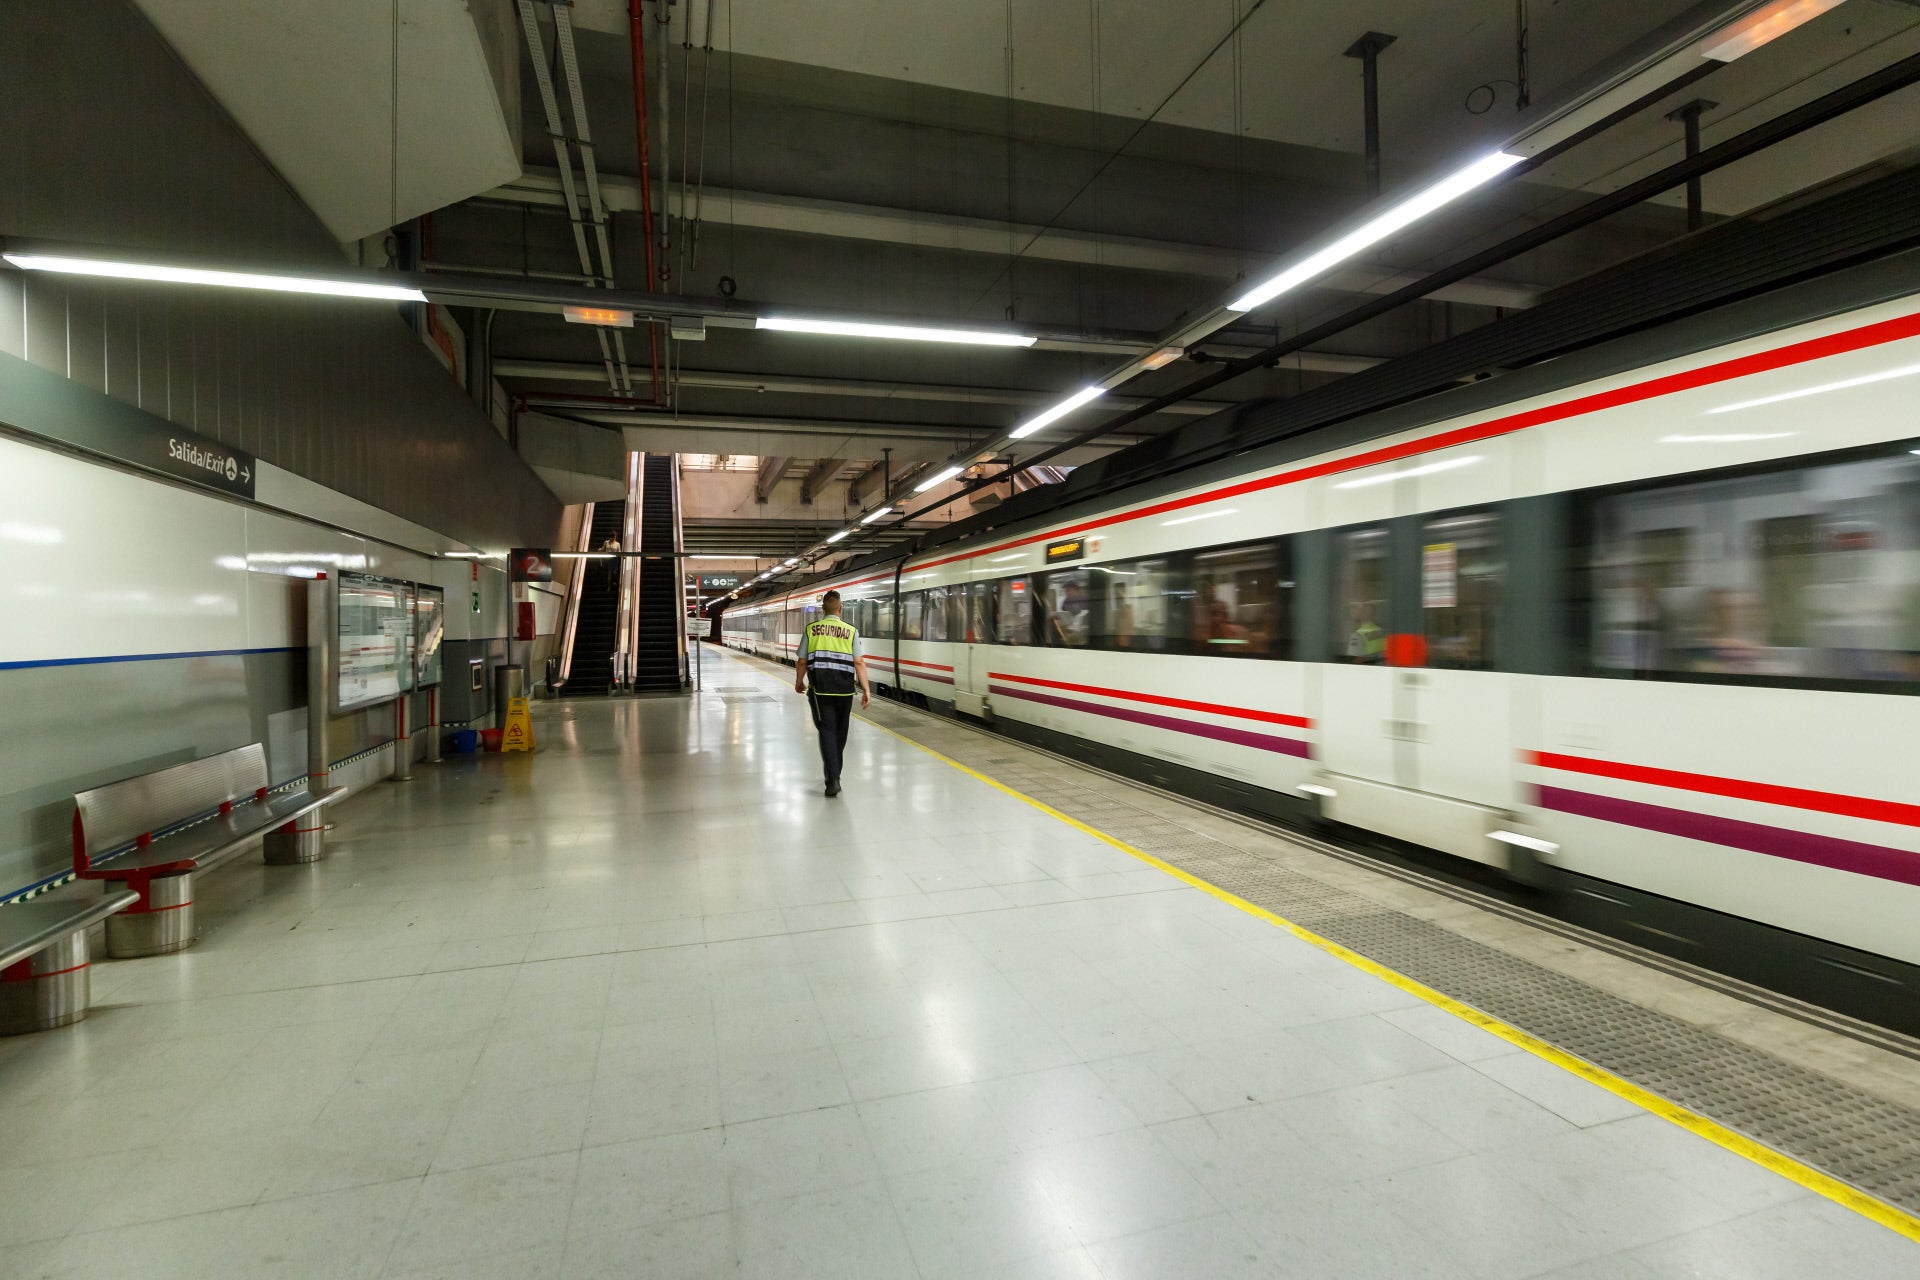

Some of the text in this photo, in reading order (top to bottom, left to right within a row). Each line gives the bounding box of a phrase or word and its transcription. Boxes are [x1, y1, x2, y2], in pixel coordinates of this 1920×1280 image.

[168, 438, 225, 475] Salida/Exit
[527, 556, 540, 574] 2
[811, 624, 851, 640] SEGURIDAD
